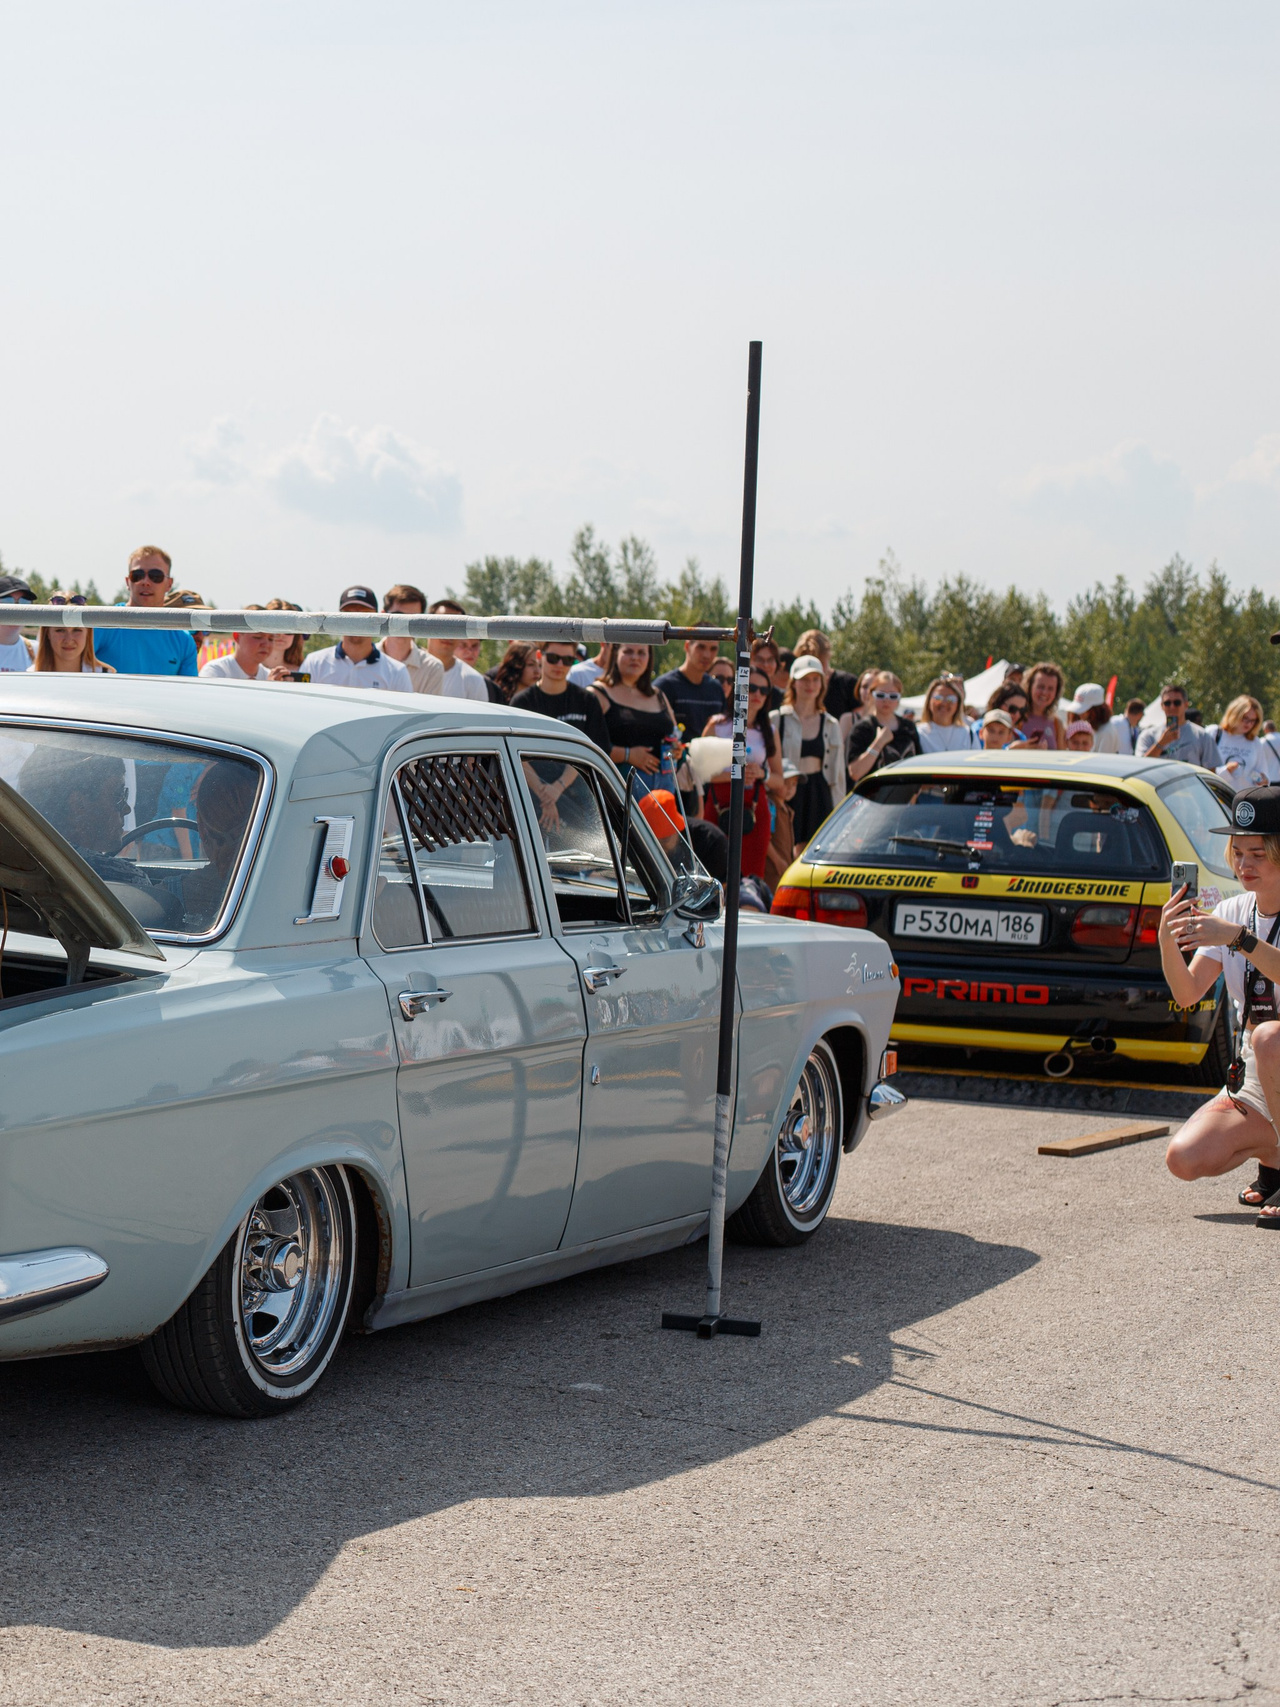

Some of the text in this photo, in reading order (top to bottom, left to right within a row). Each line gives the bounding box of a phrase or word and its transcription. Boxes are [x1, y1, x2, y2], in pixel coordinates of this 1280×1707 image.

[823, 870, 938, 888] BRIDGESTONE
[1006, 878, 1131, 897] BRIDGESTONE
[1001, 914, 1035, 933] 186
[1010, 933, 1029, 941] RUS
[903, 977, 1050, 1005] PRIMO
